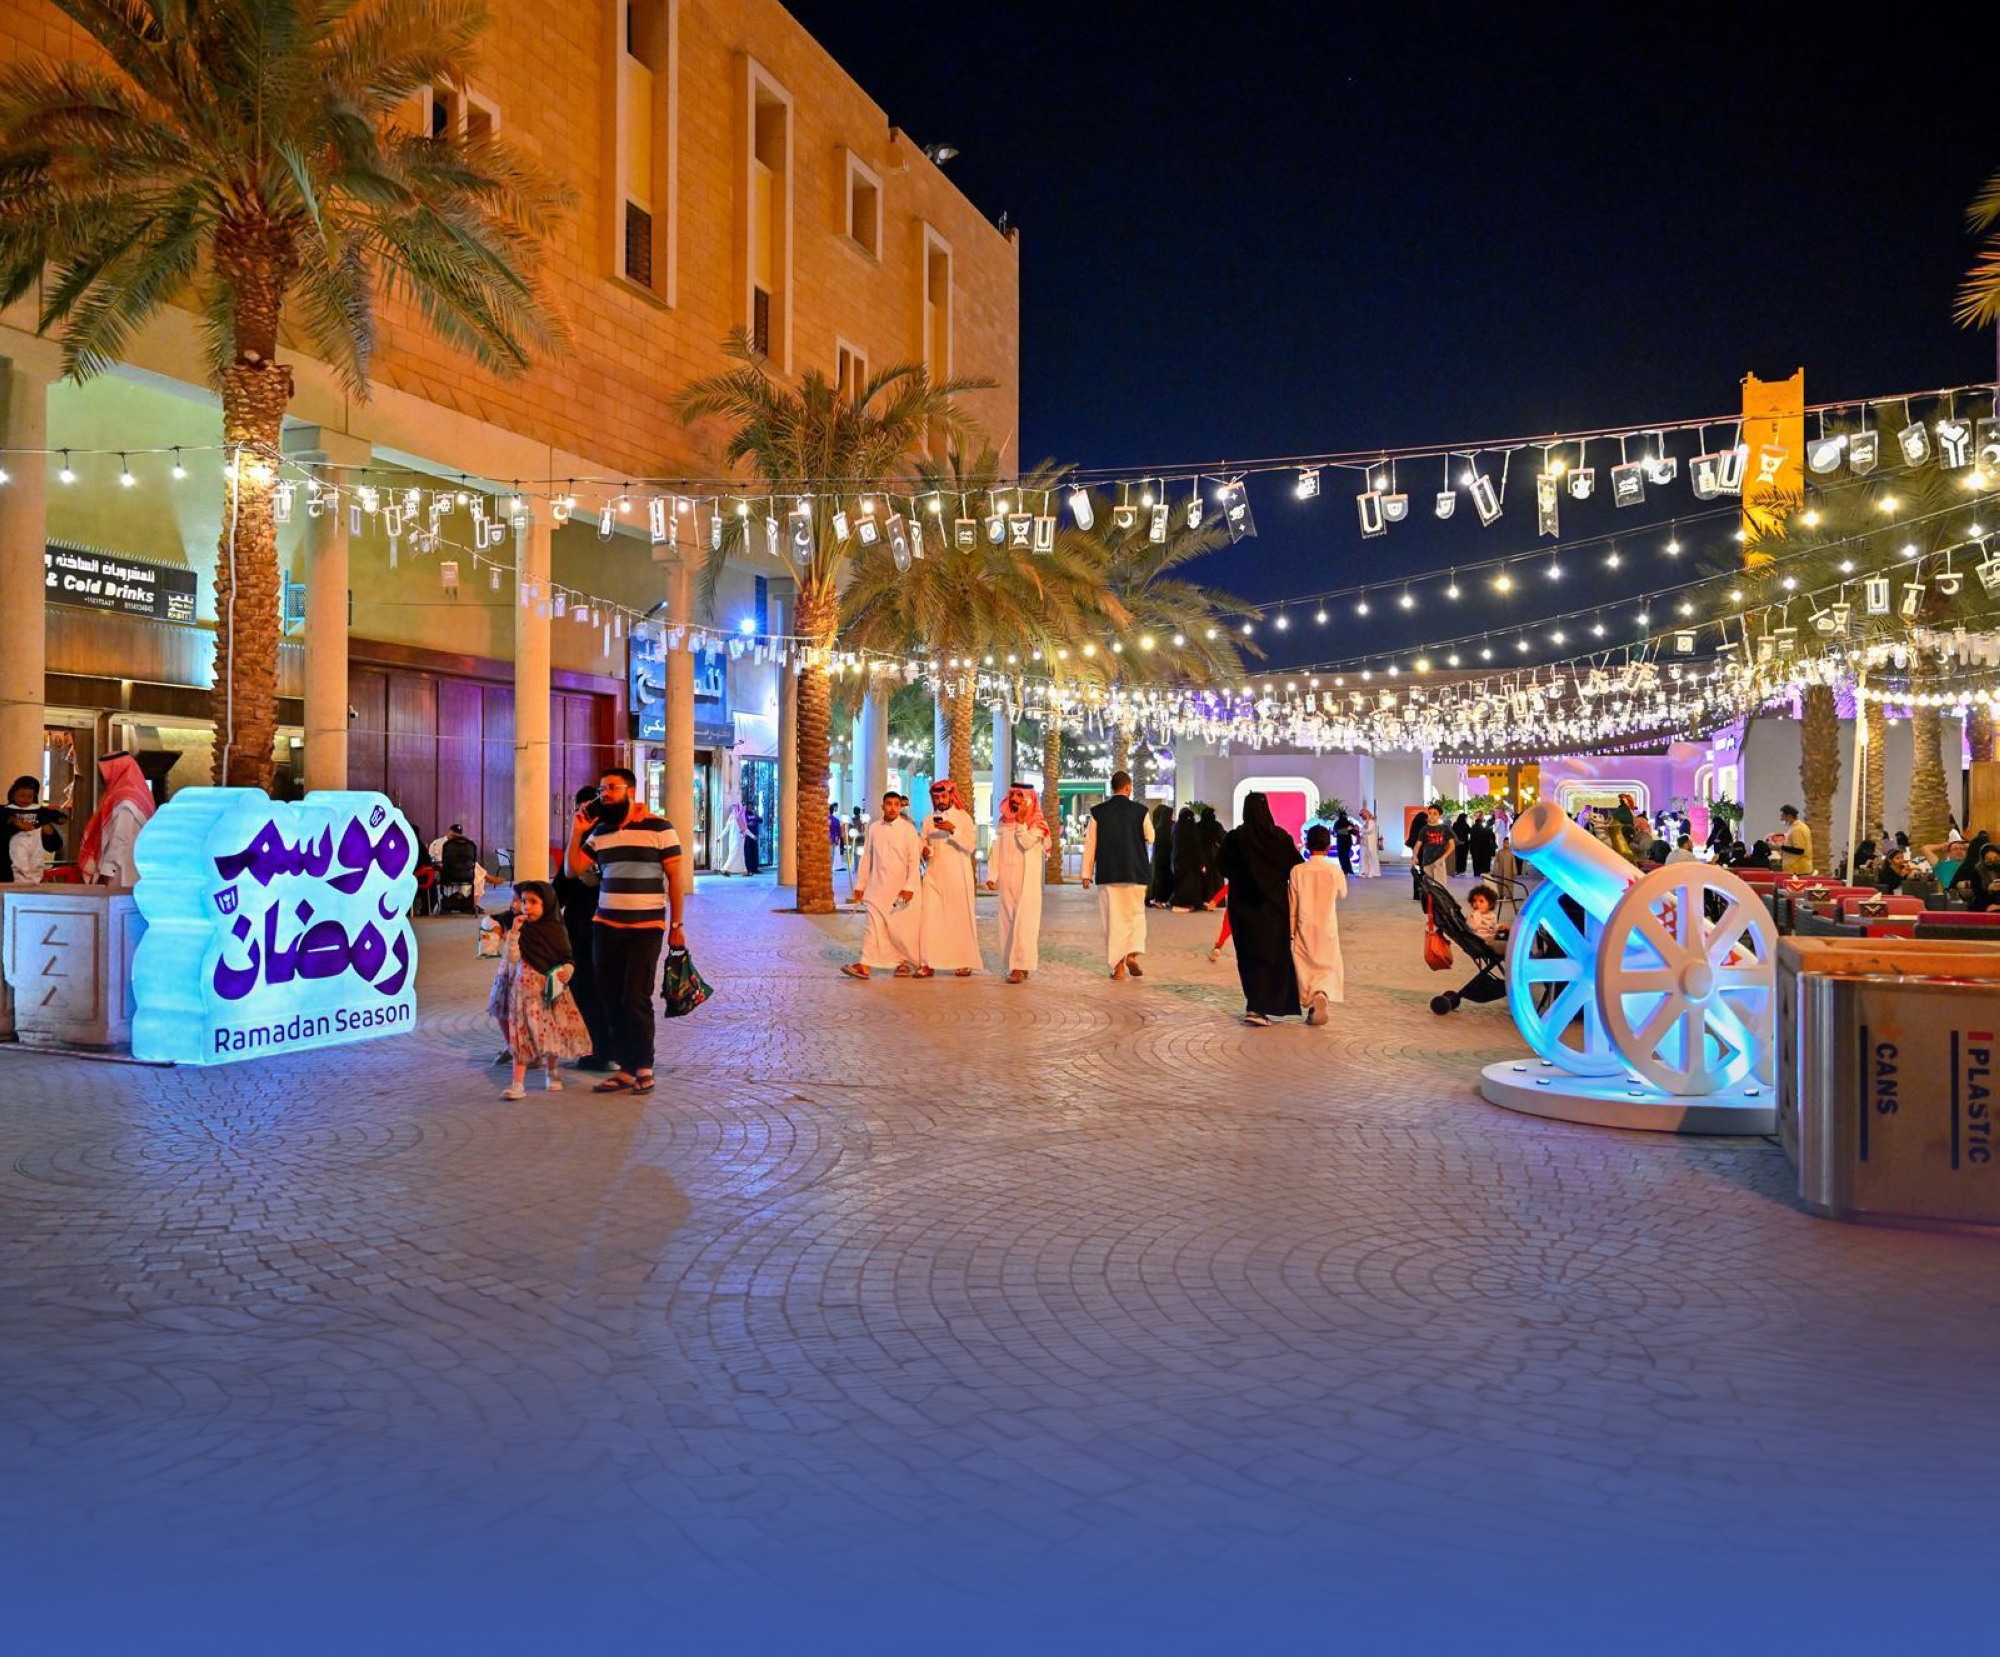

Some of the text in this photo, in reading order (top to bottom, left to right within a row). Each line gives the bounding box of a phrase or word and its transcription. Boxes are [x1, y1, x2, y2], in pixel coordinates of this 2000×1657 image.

[46, 572, 58, 587] &
[63, 574, 102, 595] Cold
[105, 582, 155, 603] Drinks
[214, 815, 411, 894] موسم
[213, 898, 410, 1001] رمضان
[214, 1003, 410, 1054] Ramadan Season
[1877, 1043, 1898, 1115] CANS
[1968, 1048, 1991, 1163] PLASTIC
